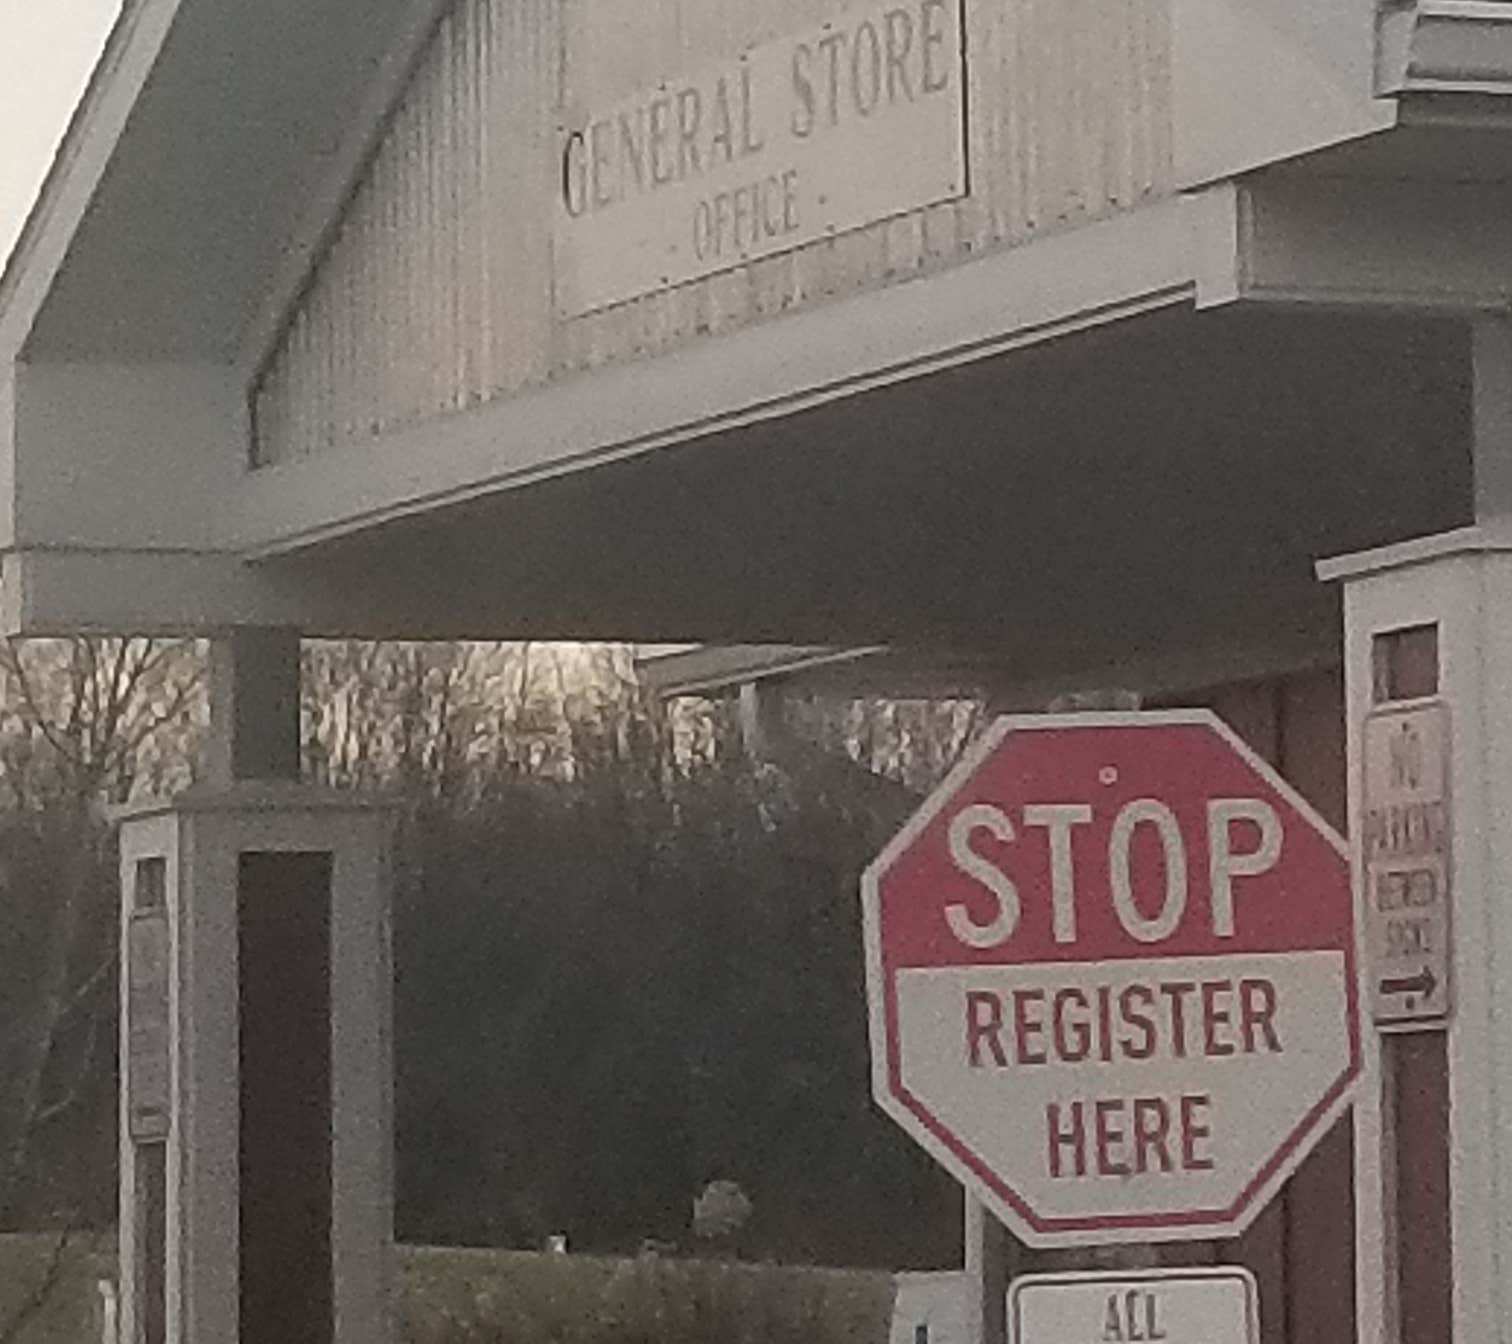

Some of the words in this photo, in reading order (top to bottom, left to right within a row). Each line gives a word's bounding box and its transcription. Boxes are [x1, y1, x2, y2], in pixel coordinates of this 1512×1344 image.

[562, 66, 764, 218] GENERAL
[693, 168, 800, 261] OFFICE
[944, 798, 1284, 949] STOP
[965, 979, 1284, 1067] REGISTER
[1046, 1096, 1214, 1177] HERE
[1102, 1289, 1166, 1342] ALL
